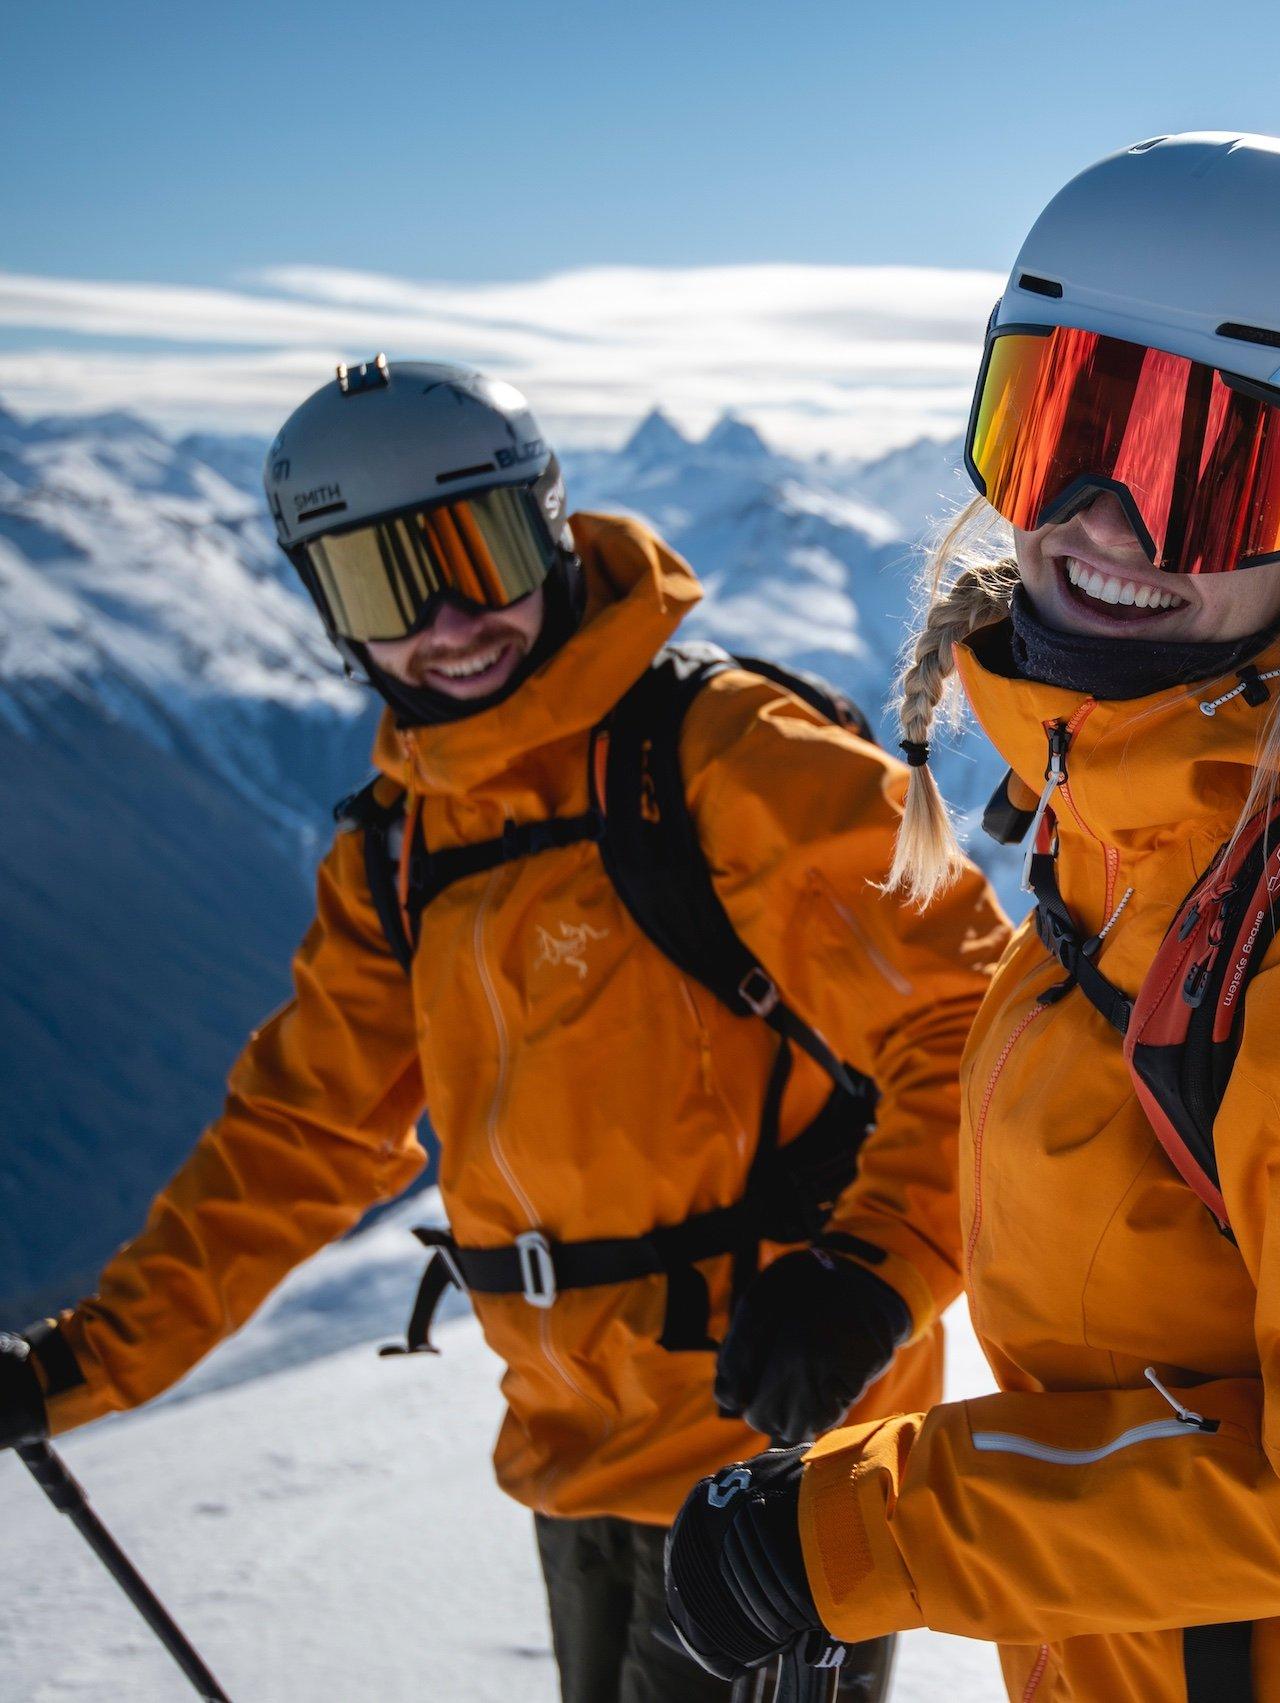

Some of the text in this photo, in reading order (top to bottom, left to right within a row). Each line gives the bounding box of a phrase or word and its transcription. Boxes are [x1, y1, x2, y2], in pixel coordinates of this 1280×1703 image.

[293, 482, 341, 509] SMITH
[1223, 910, 1265, 1007] airbag system
